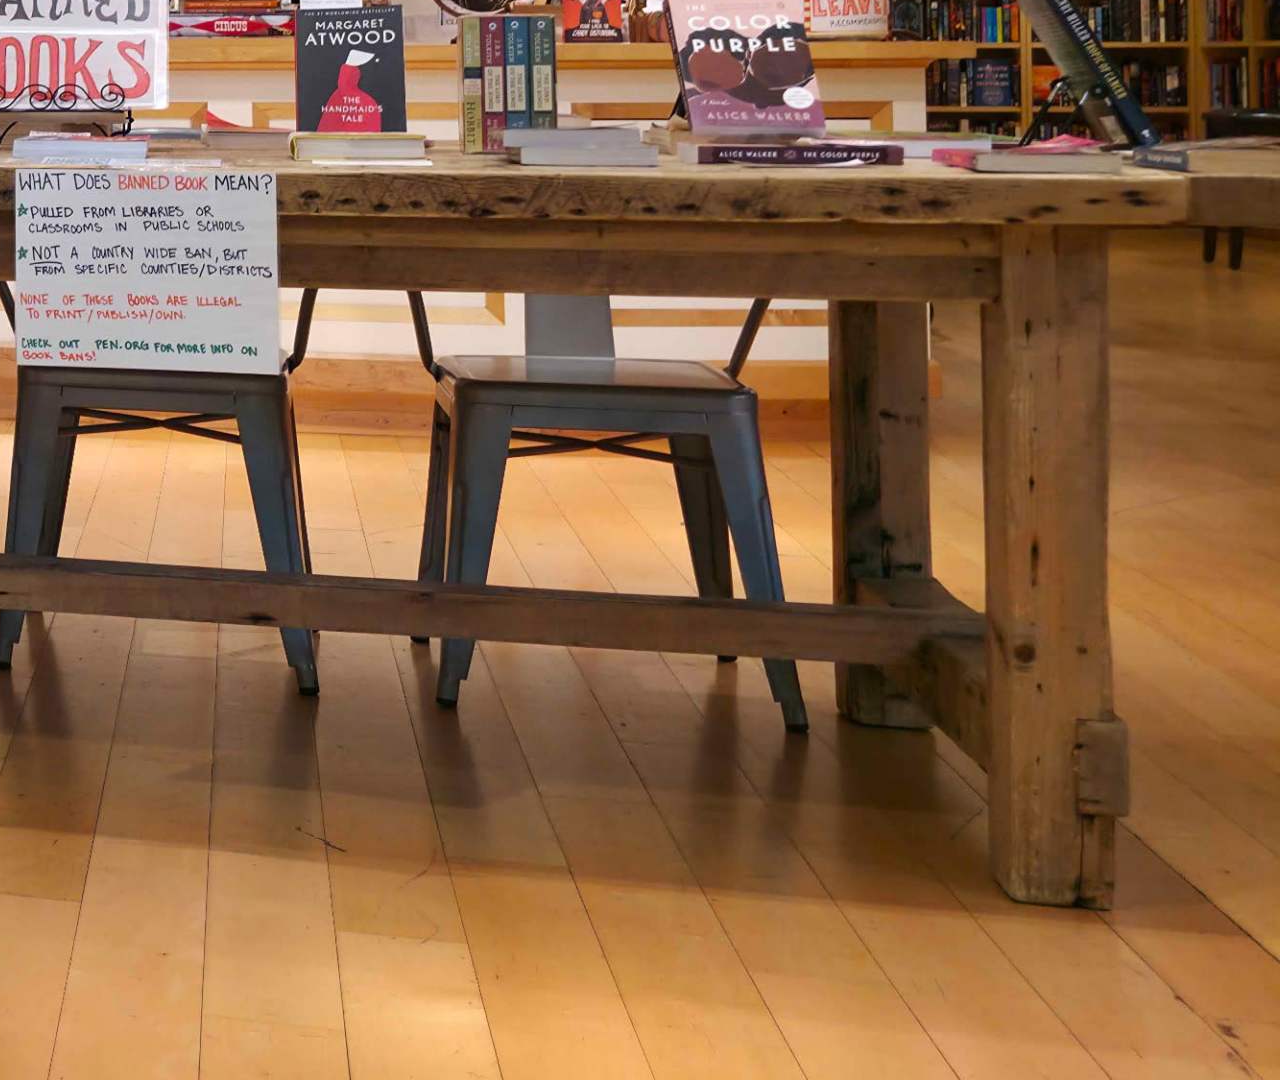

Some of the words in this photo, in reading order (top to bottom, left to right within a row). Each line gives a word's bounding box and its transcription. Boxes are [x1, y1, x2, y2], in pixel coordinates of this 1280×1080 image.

[214, 20, 247, 32] CIRCUS
[315, 19, 384, 31] MARGARET
[688, 14, 792, 32] COLOR
[305, 30, 396, 46] ATWOOD
[692, 36, 796, 52] PURPLE
[1067, 11, 1090, 41] MILLER
[1085, 39, 1104, 64] TROPIC
[1104, 72, 1127, 99] CANCER
[322, 104, 383, 113] HANDMAID'S
[342, 114, 363, 123] TALE
[707, 111, 748, 121] ALICE
[754, 111, 811, 121] WALKER
[467, 102, 476, 145] HOBBIT
[19, 173, 66, 191] WHAT
[74, 174, 111, 190] DOES
[118, 175, 169, 190] BANNED
[175, 176, 208, 191] BOOK
[215, 174, 273, 194] MEAN?
[30, 206, 73, 218] PULLED
[83, 207, 115, 217] FROM
[122, 206, 184, 218] LIBRARIES
[196, 205, 213, 217] OR
[29, 222, 103, 233] CLASSROOMS
[115, 222, 128, 232] IN
[143, 220, 190, 231] PUBLIC
[198, 220, 245, 231] SCHOOLS
[32, 245, 61, 260] NOT
[71, 248, 78, 258] A
[91, 246, 134, 260] COUNTRY
[144, 247, 177, 259] WIDE
[184, 246, 219, 263] BAN,
[223, 248, 247, 261] BUT
[35, 266, 65, 275] FROM
[75, 264, 128, 274] SPECIFIC
[140, 263, 273, 278] COUNTIES/DISTRICTS
[20, 294, 48, 305] NONE
[63, 295, 75, 305] OF
[83, 294, 113, 305] THESE
[128, 294, 159, 306] BOOKS
[167, 296, 188, 306] ARE
[197, 296, 242, 307] ILLEGAL
[26, 308, 40, 319] TO
[22, 338, 52, 349] CHECK
[59, 339, 80, 349] OUT
[95, 339, 149, 351] PEN.ORG
[155, 342, 174, 353] FOR
[177, 343, 206, 354] MORE
[210, 344, 233, 354] INFO
[241, 346, 258, 356] ON
[22, 350, 54, 361] BOOK
[59, 351, 97, 361] BANS!
